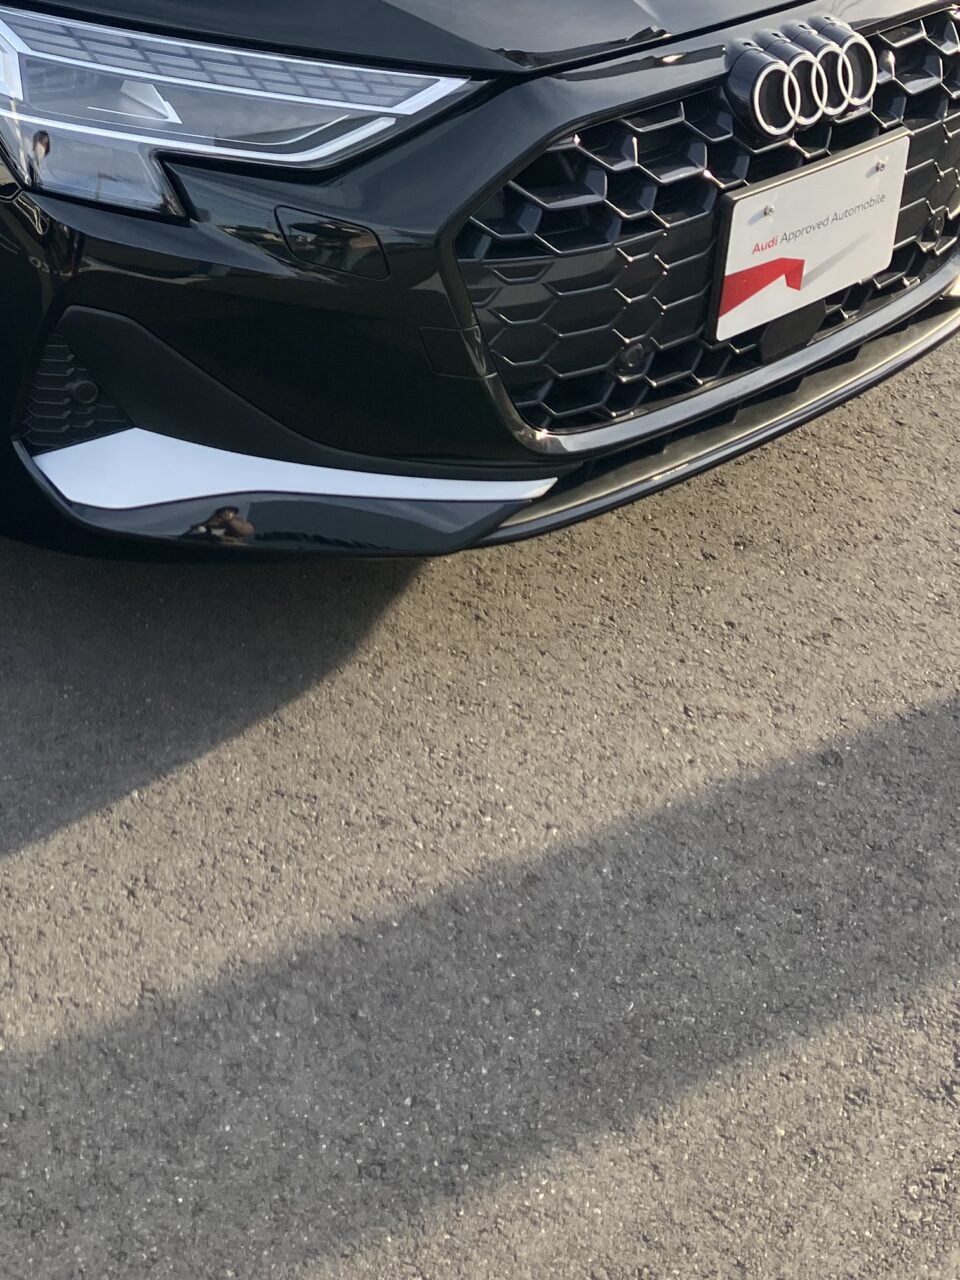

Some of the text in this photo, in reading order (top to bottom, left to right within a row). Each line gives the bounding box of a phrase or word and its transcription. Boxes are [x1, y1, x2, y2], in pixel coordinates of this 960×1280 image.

[752, 193, 886, 254] Audi Approved Automobile
